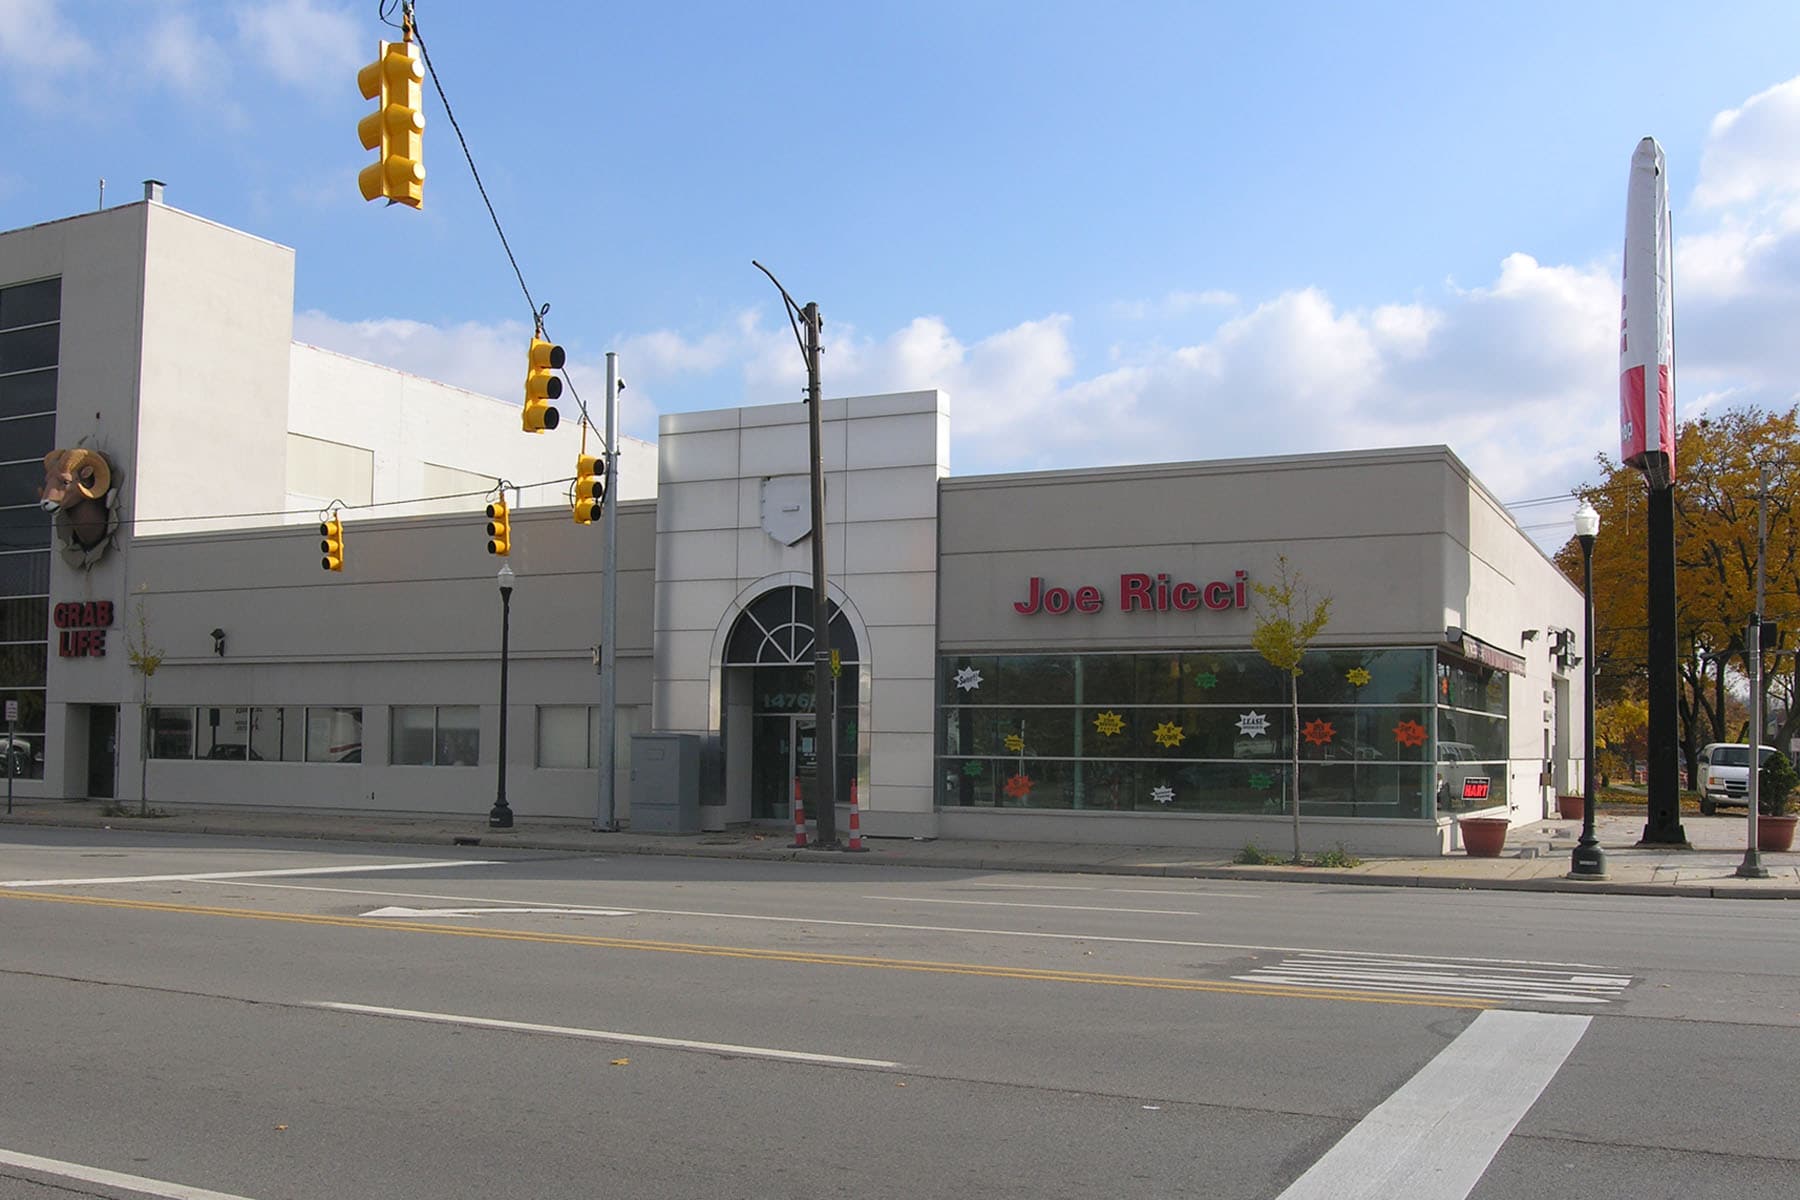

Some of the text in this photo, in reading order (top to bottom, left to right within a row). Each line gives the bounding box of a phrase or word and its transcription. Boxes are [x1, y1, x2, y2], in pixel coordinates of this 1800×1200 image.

[1013, 570, 1248, 615] Joe Ricci
[54, 601, 113, 628] GRAB
[59, 630, 106, 657] LIFE
[1242, 717, 1263, 725] LEASE
